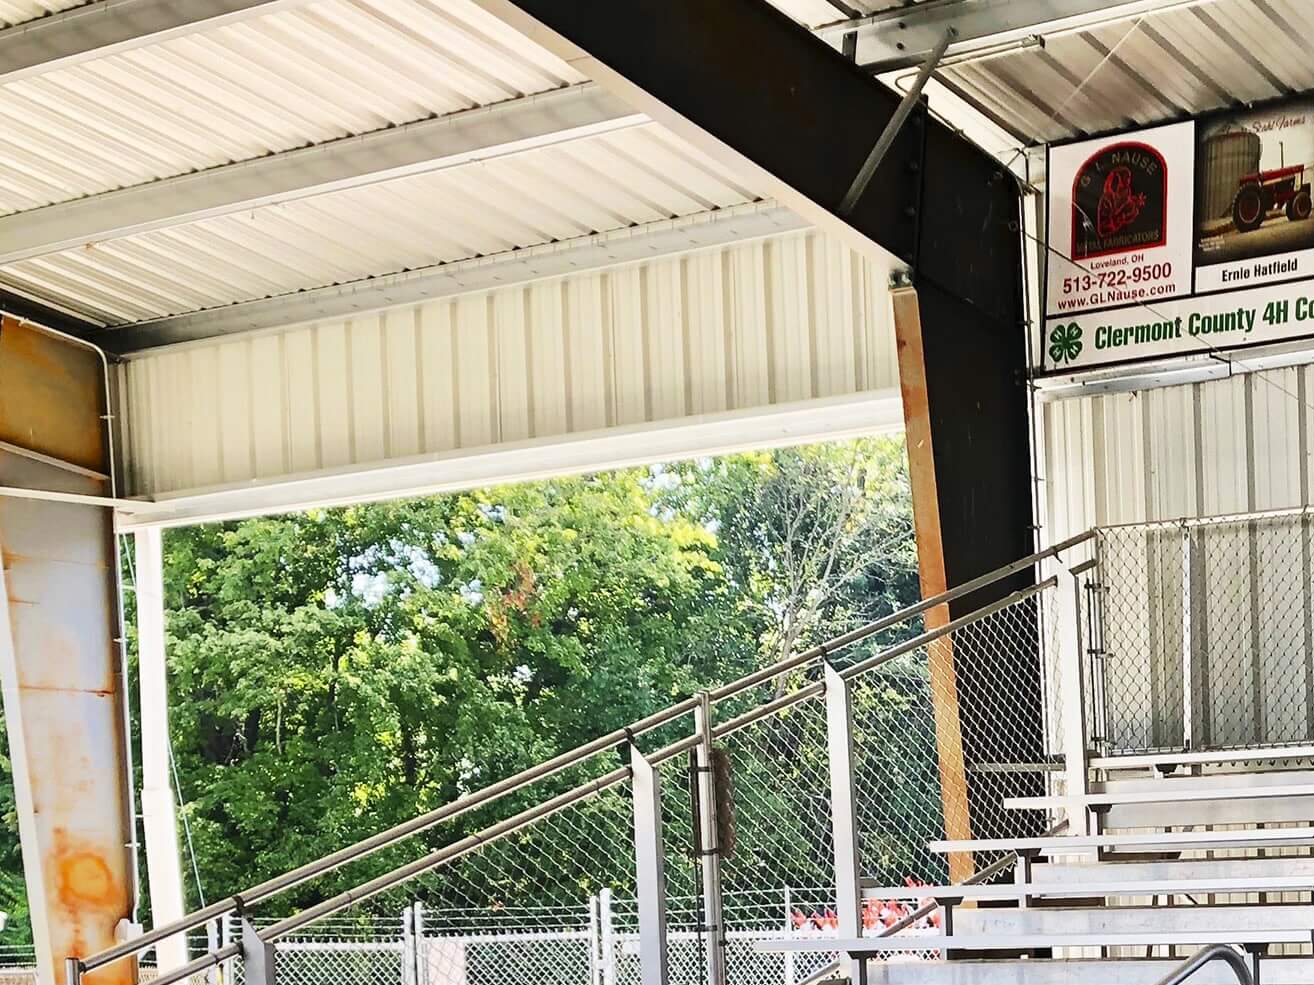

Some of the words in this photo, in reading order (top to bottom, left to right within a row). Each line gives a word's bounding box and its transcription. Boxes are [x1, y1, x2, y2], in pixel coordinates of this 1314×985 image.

[1090, 257, 1130, 270] Loveland,
[1131, 253, 1144, 263] OH
[1221, 268, 1250, 282] Ernie
[1254, 258, 1298, 277] Hatfield
[1063, 262, 1172, 294] 513-722-9500
[1057, 283, 1176, 310] www.GLNause.com
[1094, 316, 1182, 350] Clermont
[1188, 307, 1256, 337] County
[1262, 299, 1289, 325] 4H
